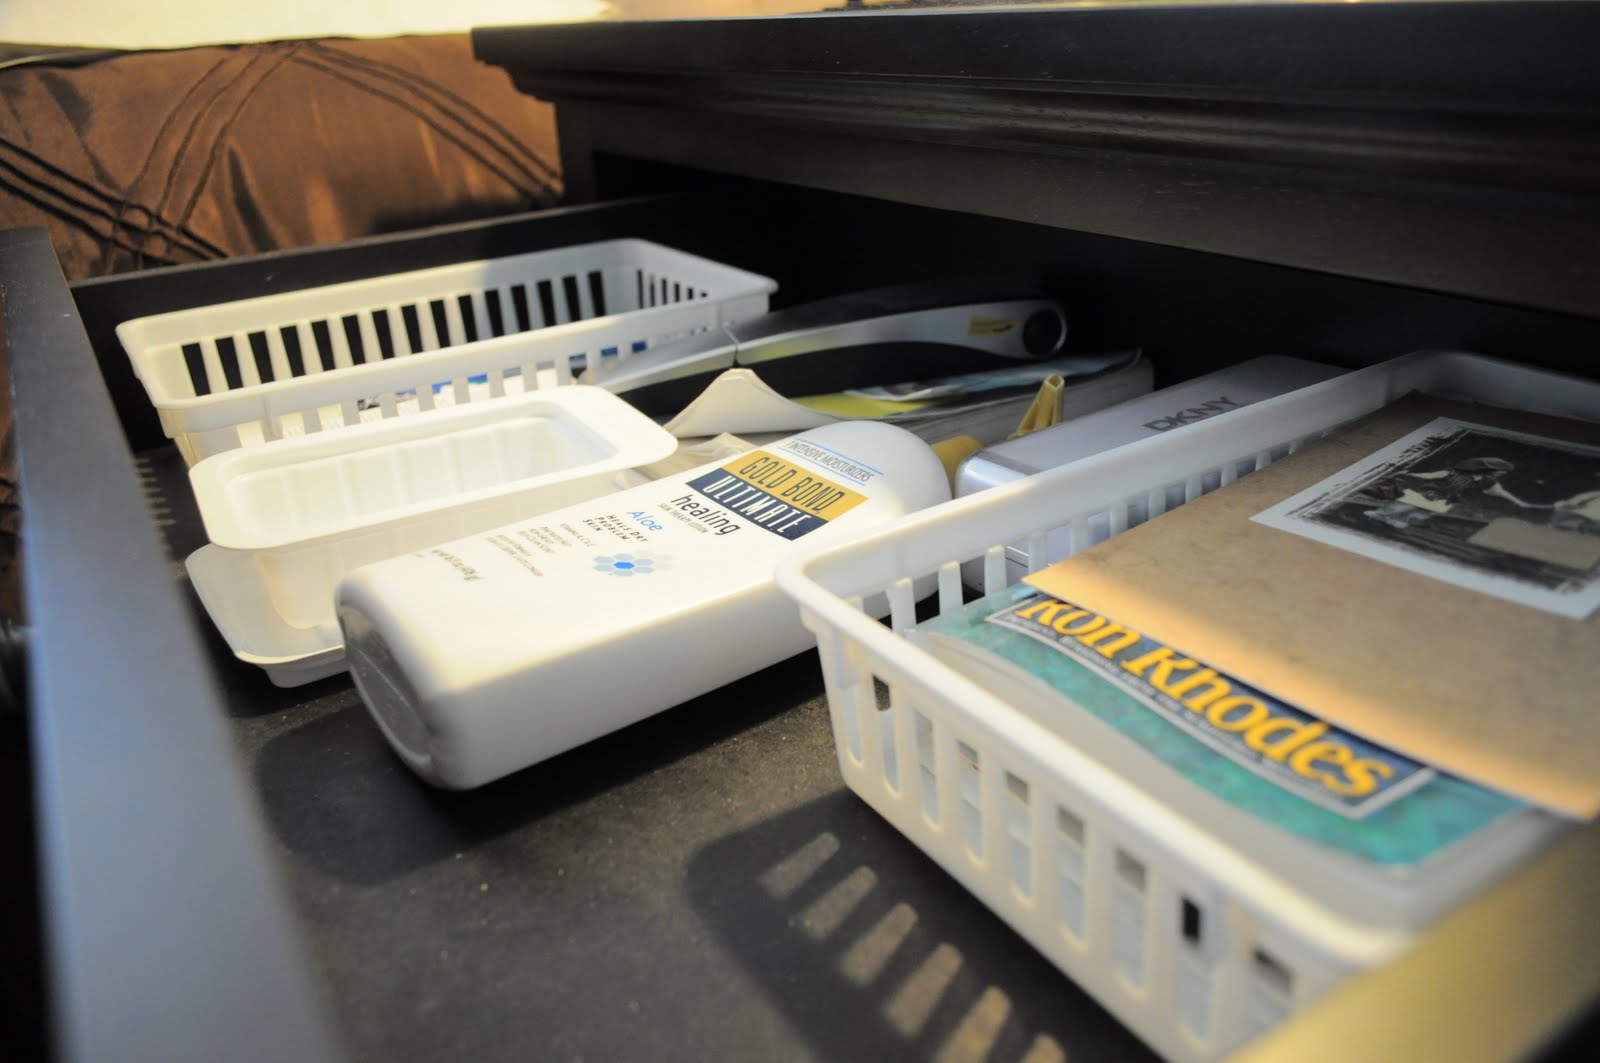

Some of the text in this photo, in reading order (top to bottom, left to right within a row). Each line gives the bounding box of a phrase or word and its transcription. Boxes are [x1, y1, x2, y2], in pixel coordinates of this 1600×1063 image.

[1142, 396, 1239, 432] DKNY
[789, 442, 826, 461] INTENSIVE
[821, 454, 874, 482] MOISTURIZERS
[739, 456, 846, 512] GOLD BOND
[626, 511, 663, 531] Aloe
[670, 494, 741, 535] healing
[703, 475, 812, 533] ULTIMATE
[582, 519, 603, 532] SKIN
[594, 517, 630, 540] PROBLEM
[605, 515, 648, 542] HEALS DRY
